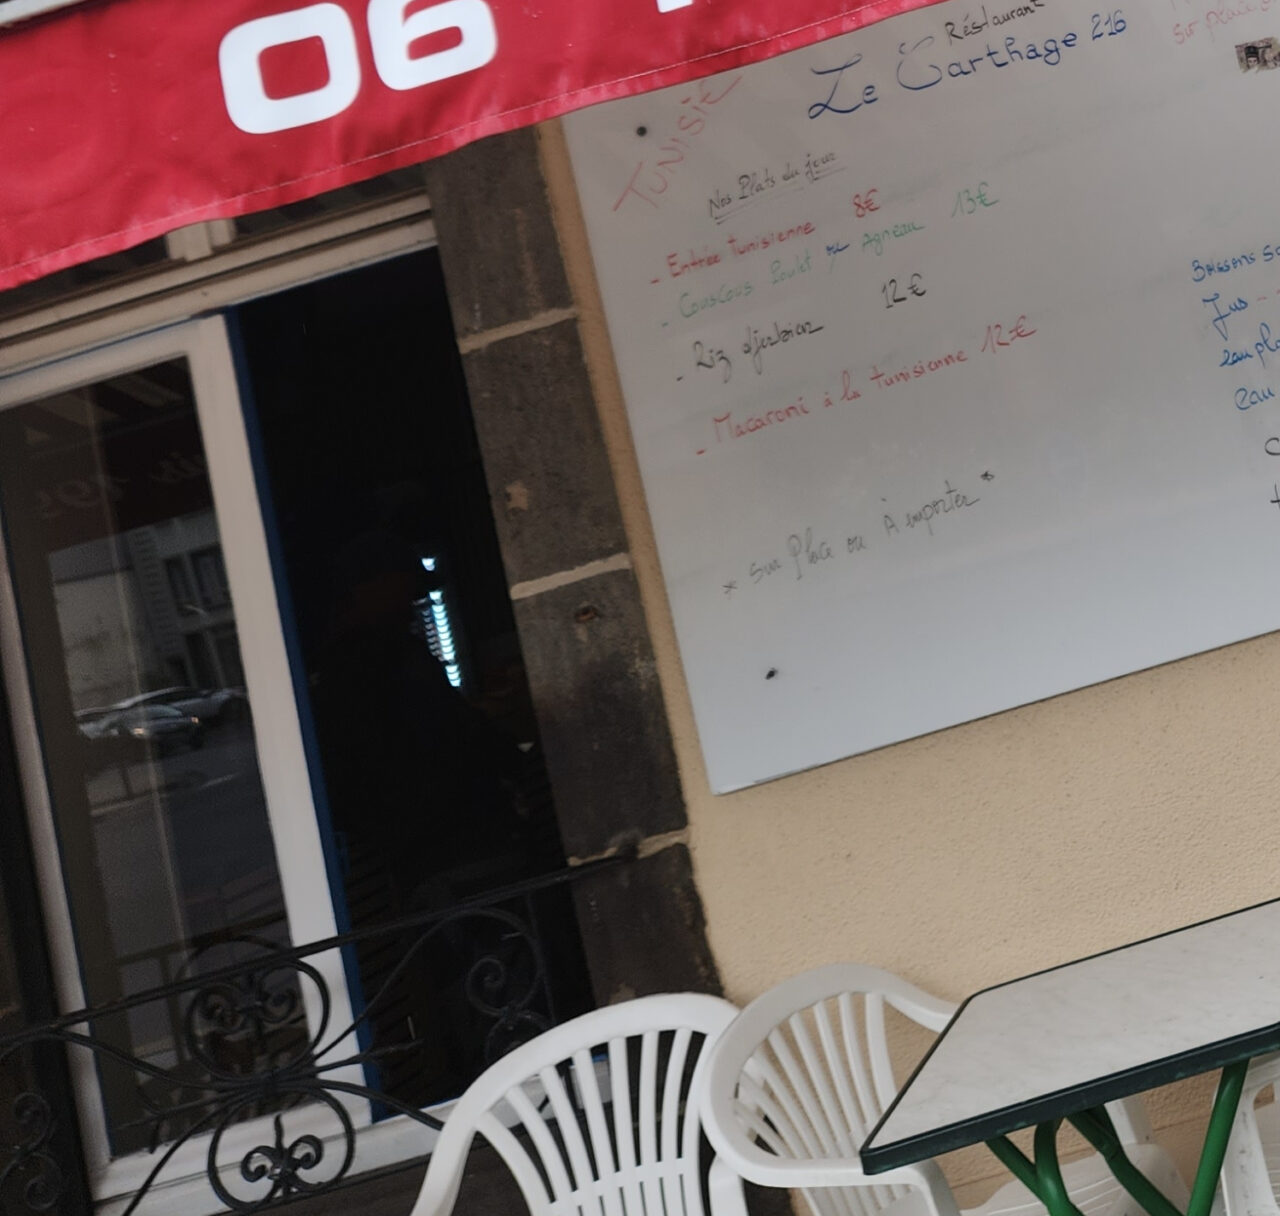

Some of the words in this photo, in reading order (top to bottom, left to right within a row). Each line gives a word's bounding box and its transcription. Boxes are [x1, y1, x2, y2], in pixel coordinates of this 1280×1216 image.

[897, 31, 1078, 91] Carthage
[1091, 9, 1127, 41] 216
[1202, 293, 1249, 340] Jus
